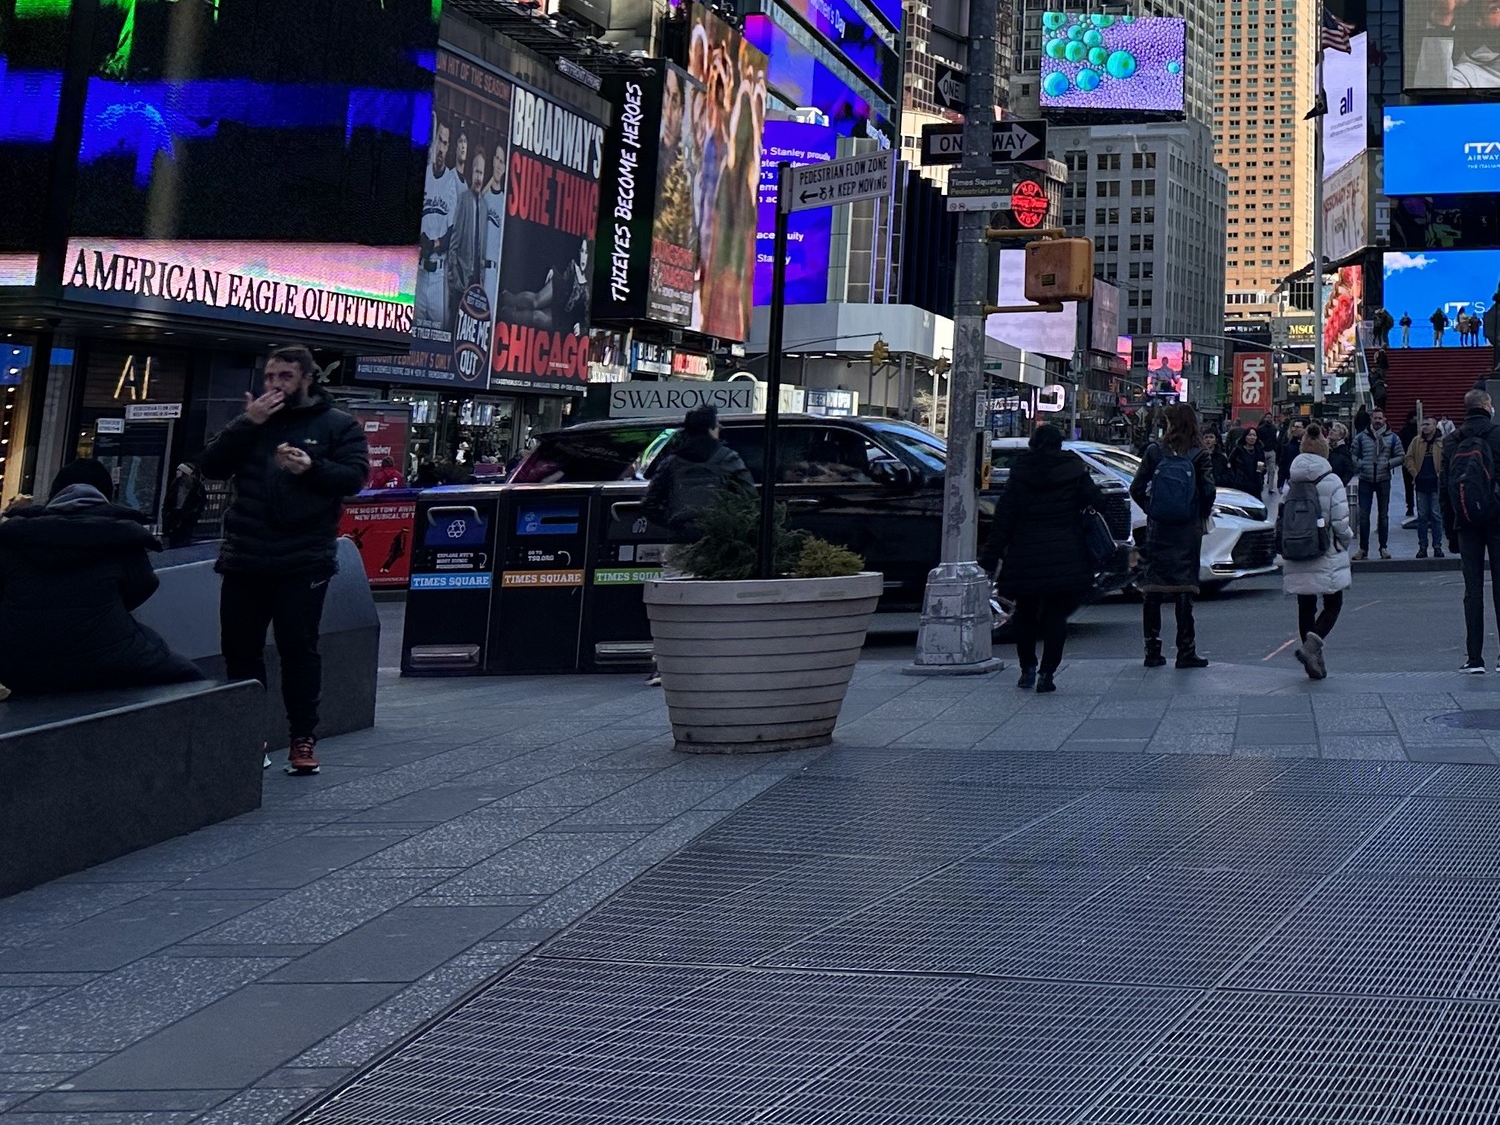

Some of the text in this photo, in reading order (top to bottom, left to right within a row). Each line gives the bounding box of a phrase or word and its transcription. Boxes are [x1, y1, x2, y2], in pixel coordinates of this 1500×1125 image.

[834, 9, 846, 39] Day
[943, 79, 960, 95] ONE
[1339, 87, 1353, 116] all
[511, 86, 604, 179] BROADWAY'S
[766, 147, 806, 159] Stanley
[939, 136, 963, 152] ON
[800, 156, 888, 185] PEDESTRIAN FLOW ZONE
[611, 81, 644, 302] THIEVES BECOME HEROES
[837, 176, 888, 197] KEEP MOVING
[950, 186, 1010, 195] Pedestrian Plaza
[951, 177, 1003, 187] Times Square
[508, 151, 599, 242] SURE THING
[62, 248, 225, 307] AMERICAN
[227, 274, 298, 316] EAGLE
[301, 287, 415, 334] OUTFITTERS
[456, 308, 491, 353] TAKE ME
[492, 321, 590, 381] CHICAGO
[637, 341, 659, 361] BLUE
[435, 354, 452, 371] ONLY
[459, 350, 479, 376] OUT
[1243, 358, 1260, 405] tkts
[612, 388, 751, 410] SWAROVSKI
[413, 577, 447, 587] TIMES
[448, 576, 489, 586] SQUARE
[504, 573, 582, 584] TIMES SQUARE
[596, 572, 630, 582] TIMES
